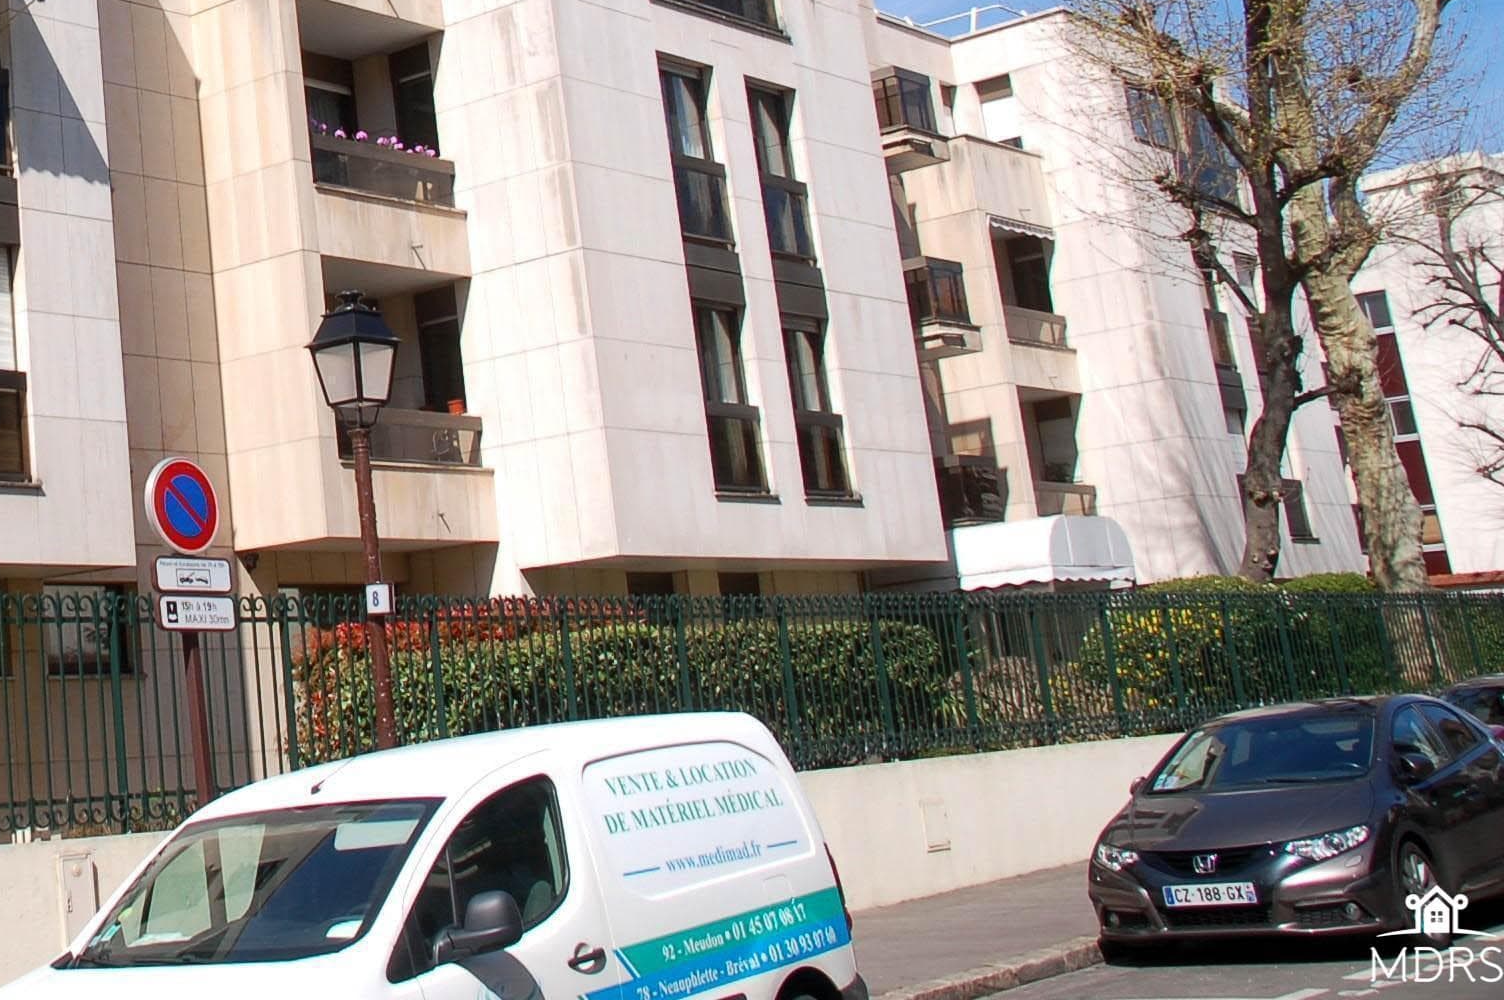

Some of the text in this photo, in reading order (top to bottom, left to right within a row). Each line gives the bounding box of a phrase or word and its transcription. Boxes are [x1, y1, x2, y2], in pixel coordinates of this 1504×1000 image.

[372, 591, 379, 607] 8
[185, 614, 207, 624] MAXI
[604, 758, 758, 797] VENTE & LOCATION
[603, 788, 784, 835] DE MATÉRIEL MÉDICAL
[665, 840, 762, 872] www.medimad.fr
[662, 944, 676, 962] 92
[683, 934, 724, 955] Meudon
[731, 922, 746, 940] 01
[748, 916, 763, 935] 45
[763, 912, 779, 931] 07
[778, 907, 794, 926] 08
[658, 967, 718, 996] Neauphlette
[726, 954, 759, 976] Bréval
[768, 943, 784, 963] 01
[784, 938, 799, 956] 30
[799, 933, 813, 952] 93
[813, 929, 826, 948] 07
